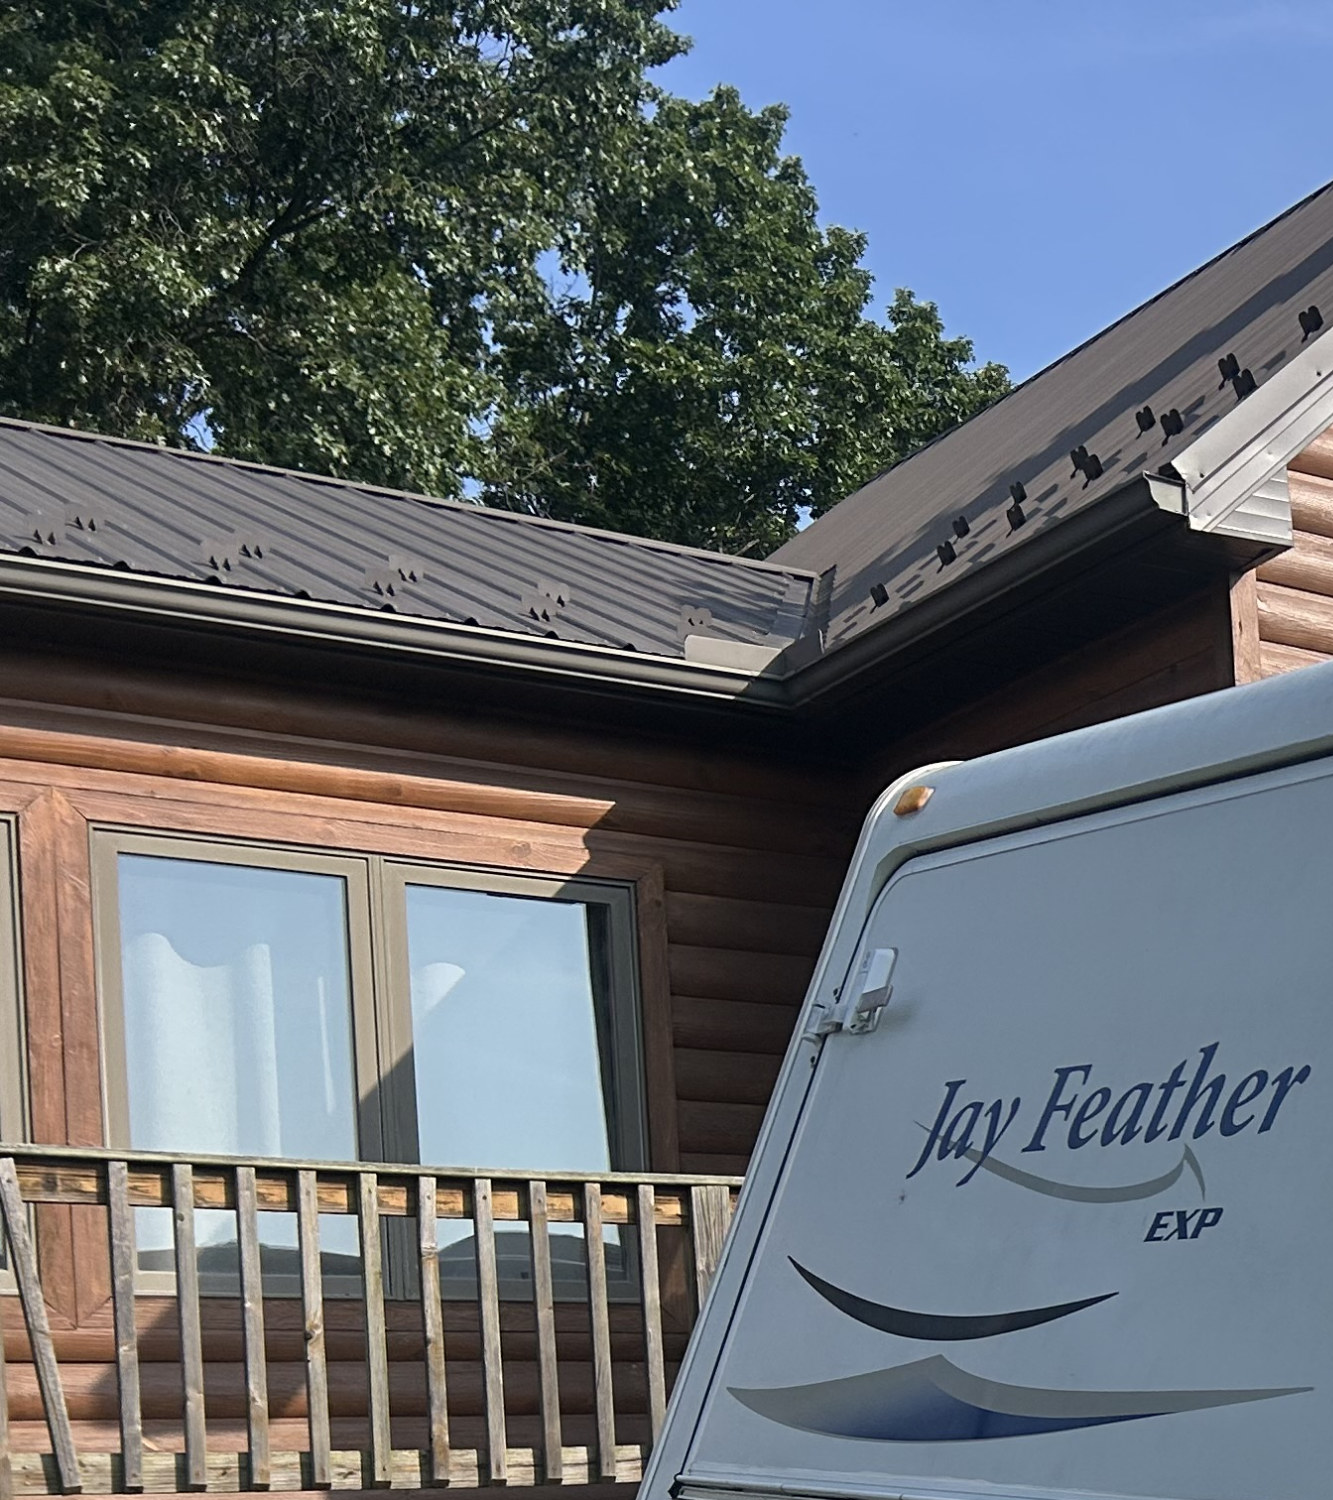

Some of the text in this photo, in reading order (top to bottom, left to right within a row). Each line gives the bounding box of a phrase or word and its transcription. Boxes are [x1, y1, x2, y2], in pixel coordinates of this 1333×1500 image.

[906, 1041, 1312, 1188] Jay Feather
[1143, 1207, 1224, 1243] EXP
